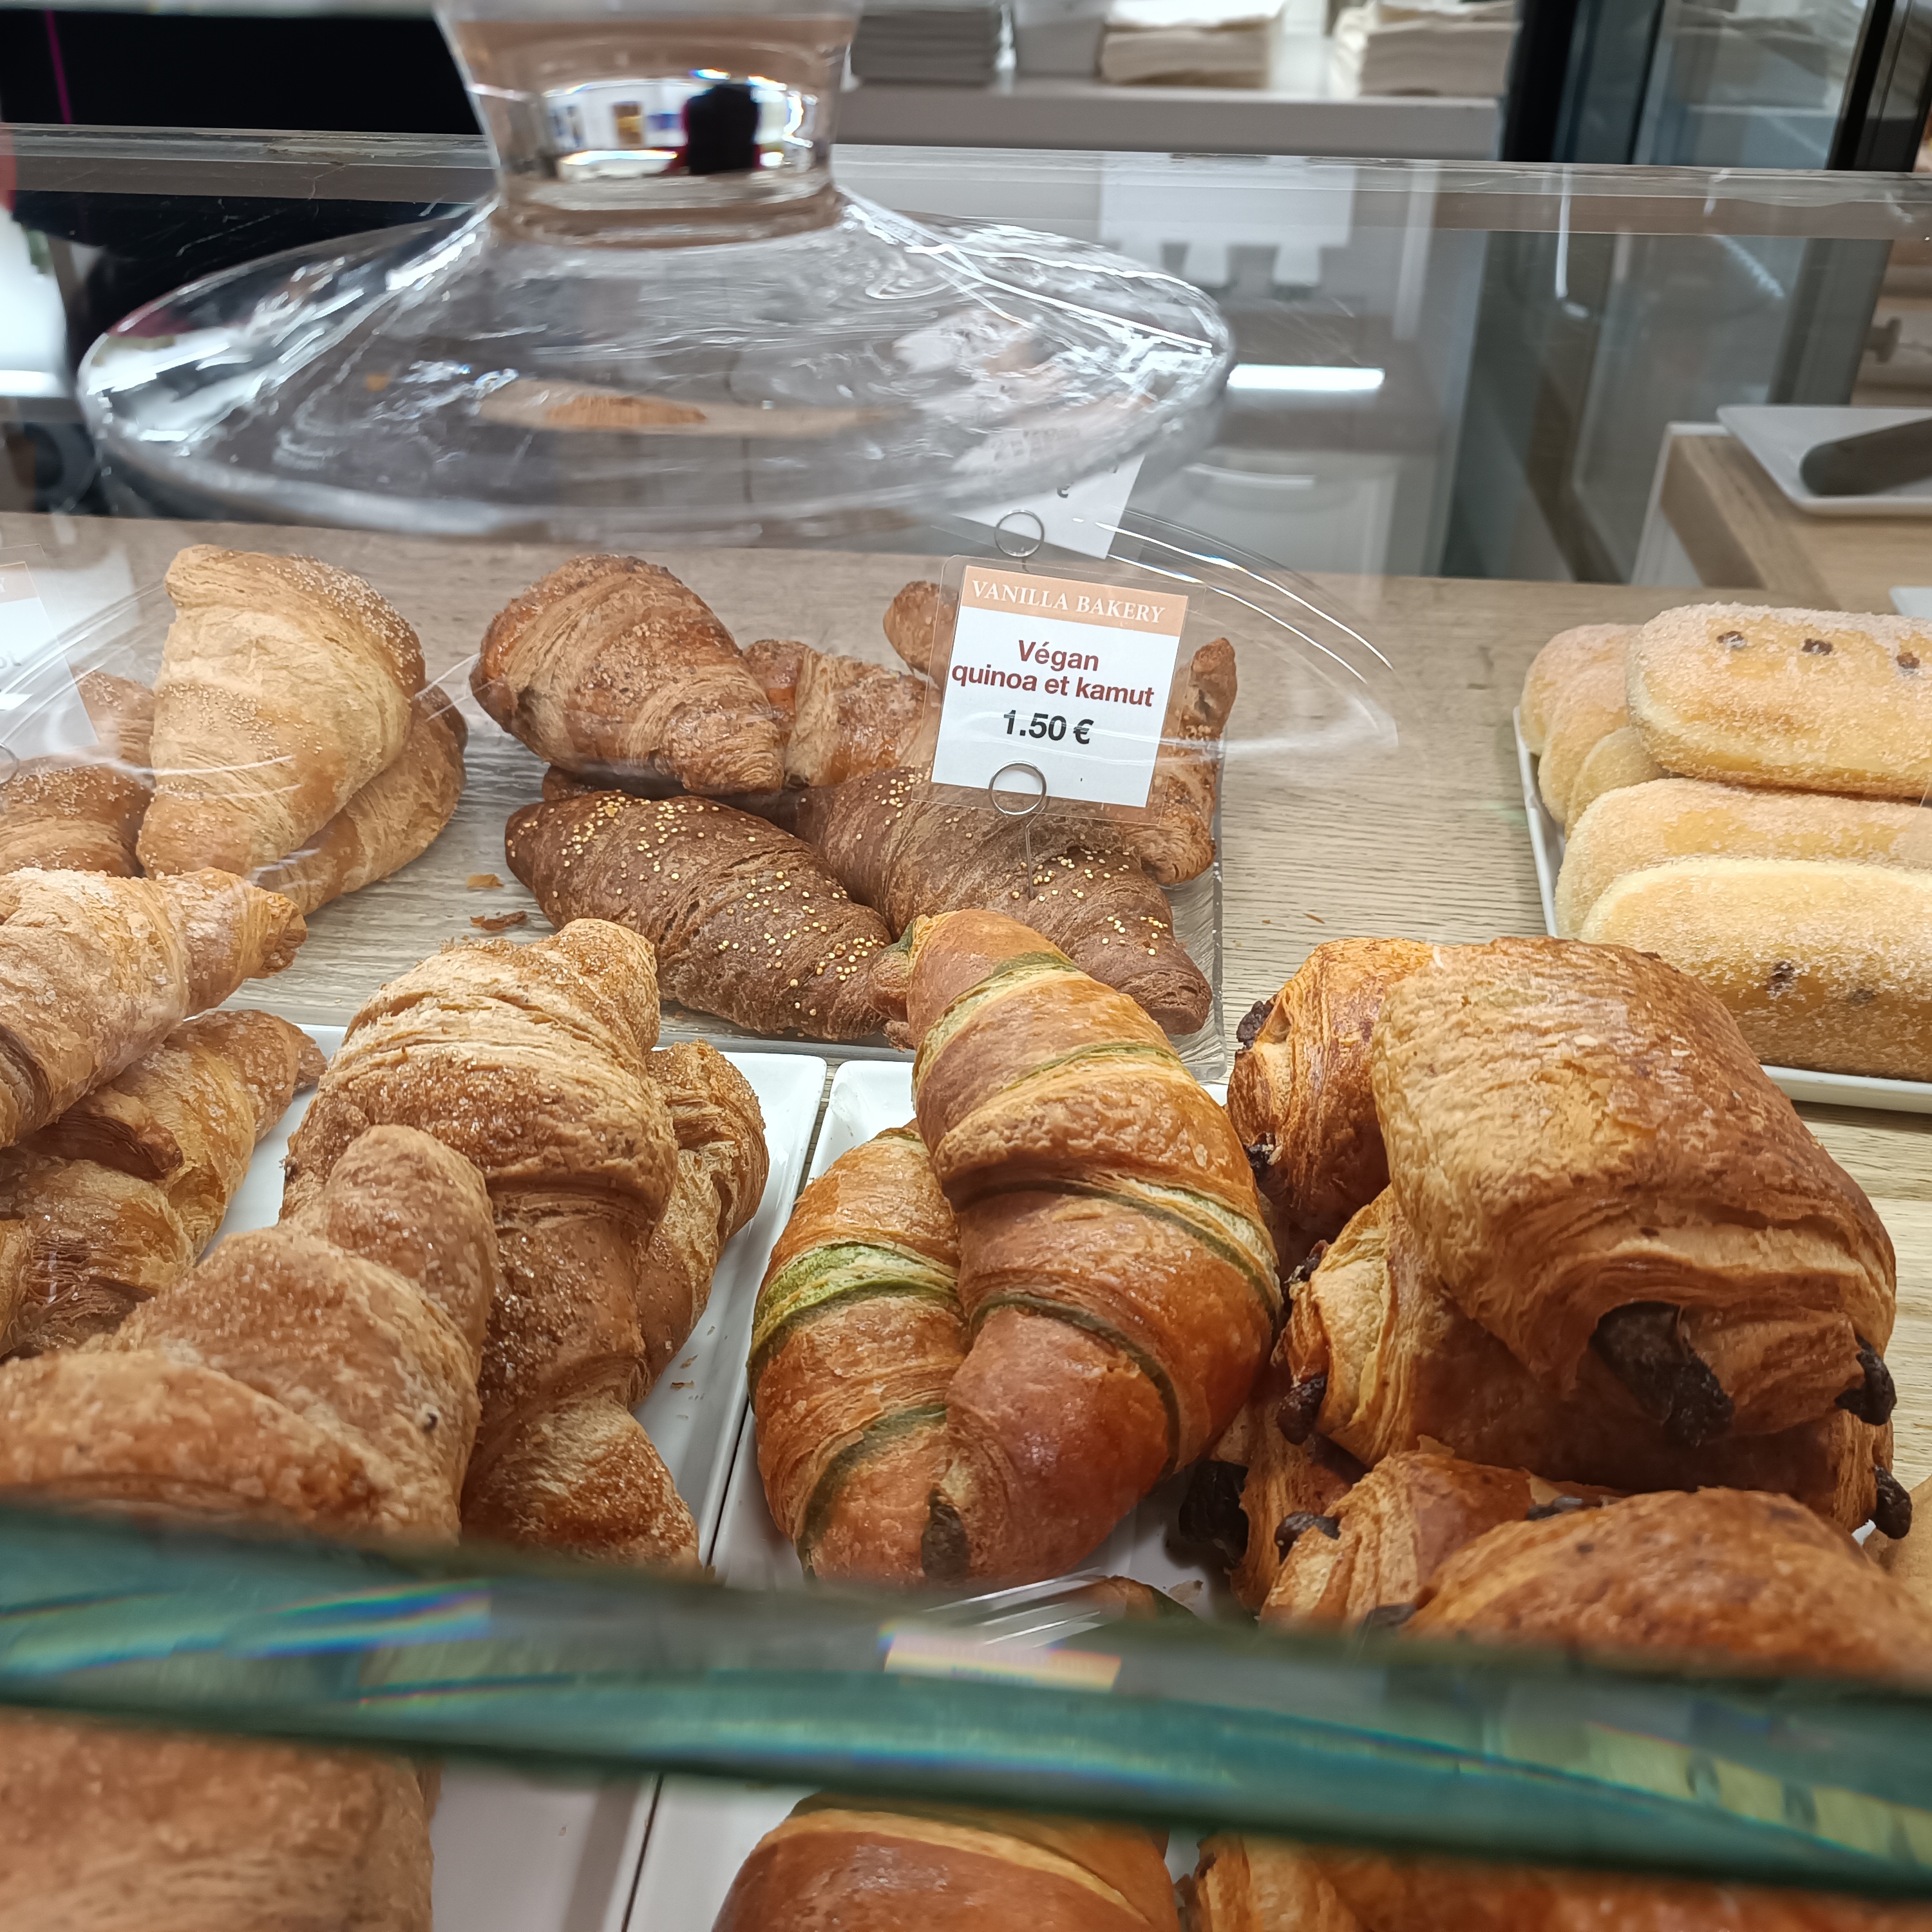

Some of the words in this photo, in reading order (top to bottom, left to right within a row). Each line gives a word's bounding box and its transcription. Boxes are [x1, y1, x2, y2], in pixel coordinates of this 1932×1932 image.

[972, 581, 1068, 611] VANILLA
[1075, 596, 1166, 623] BAKERY
[1018, 639, 1099, 672] Végan
[952, 664, 1037, 692] quinoa
[1045, 677, 1070, 696] et
[1075, 676, 1155, 707] kamut
[1003, 710, 1066, 741] 1.50
[1074, 719, 1095, 744] €
